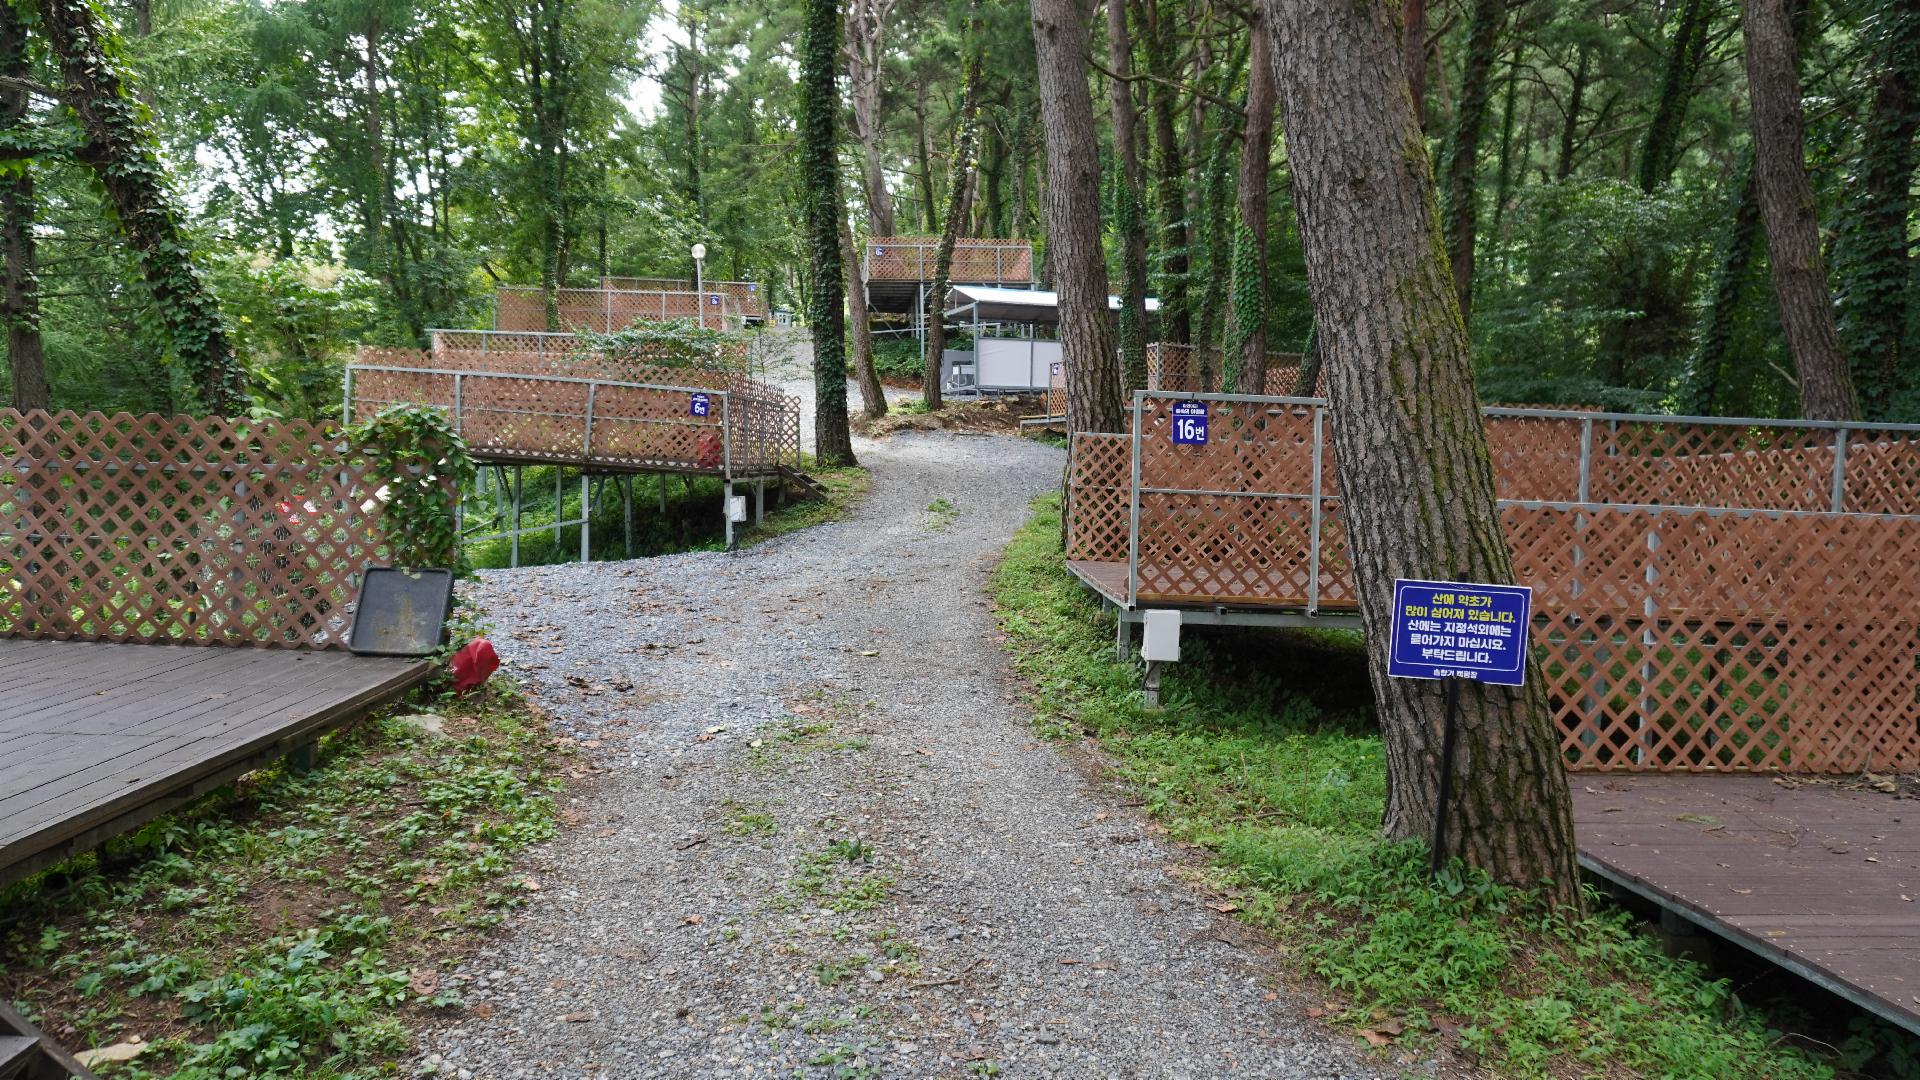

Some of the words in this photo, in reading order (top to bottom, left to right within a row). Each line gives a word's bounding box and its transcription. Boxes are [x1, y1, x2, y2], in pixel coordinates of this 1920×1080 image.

[1177, 418, 1205, 441] 16번
[1458, 594, 1492, 608] 약초가
[1405, 605, 1427, 617] 많이
[1431, 607, 1464, 620] 심어져
[1468, 609, 1516, 623] 있습니다.
[1407, 619, 1441, 632] 산에는
[1444, 622, 1512, 637] 지정석외에는
[1410, 633, 1454, 647] 들어가지
[1458, 637, 1506, 651] 마십시요.
[1422, 648, 1492, 664] 부탁드립니다.
